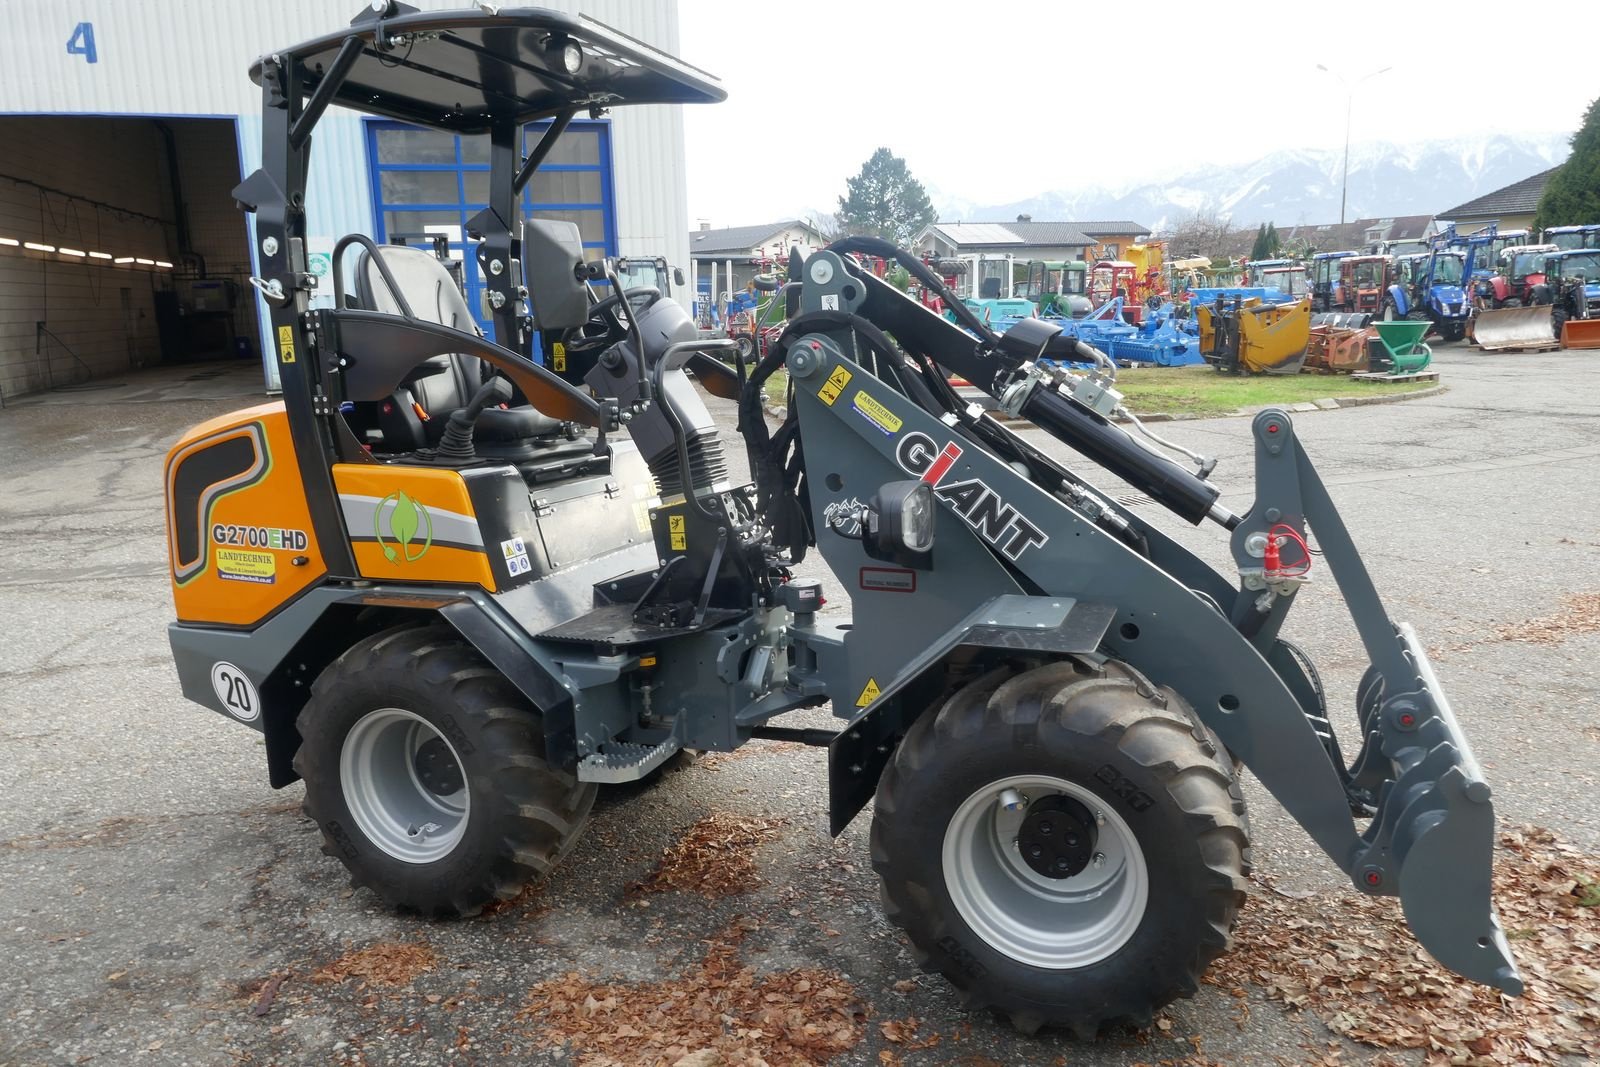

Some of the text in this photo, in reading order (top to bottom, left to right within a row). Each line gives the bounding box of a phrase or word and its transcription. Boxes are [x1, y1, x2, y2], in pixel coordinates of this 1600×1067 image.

[66, 22, 98, 64] 4
[858, 392, 900, 426] LANDTECHNIK
[212, 523, 308, 552] G2700EHD
[218, 551, 272, 564] LANDTECHNIK
[220, 671, 251, 712] 20
[1094, 764, 1156, 812] BKT
